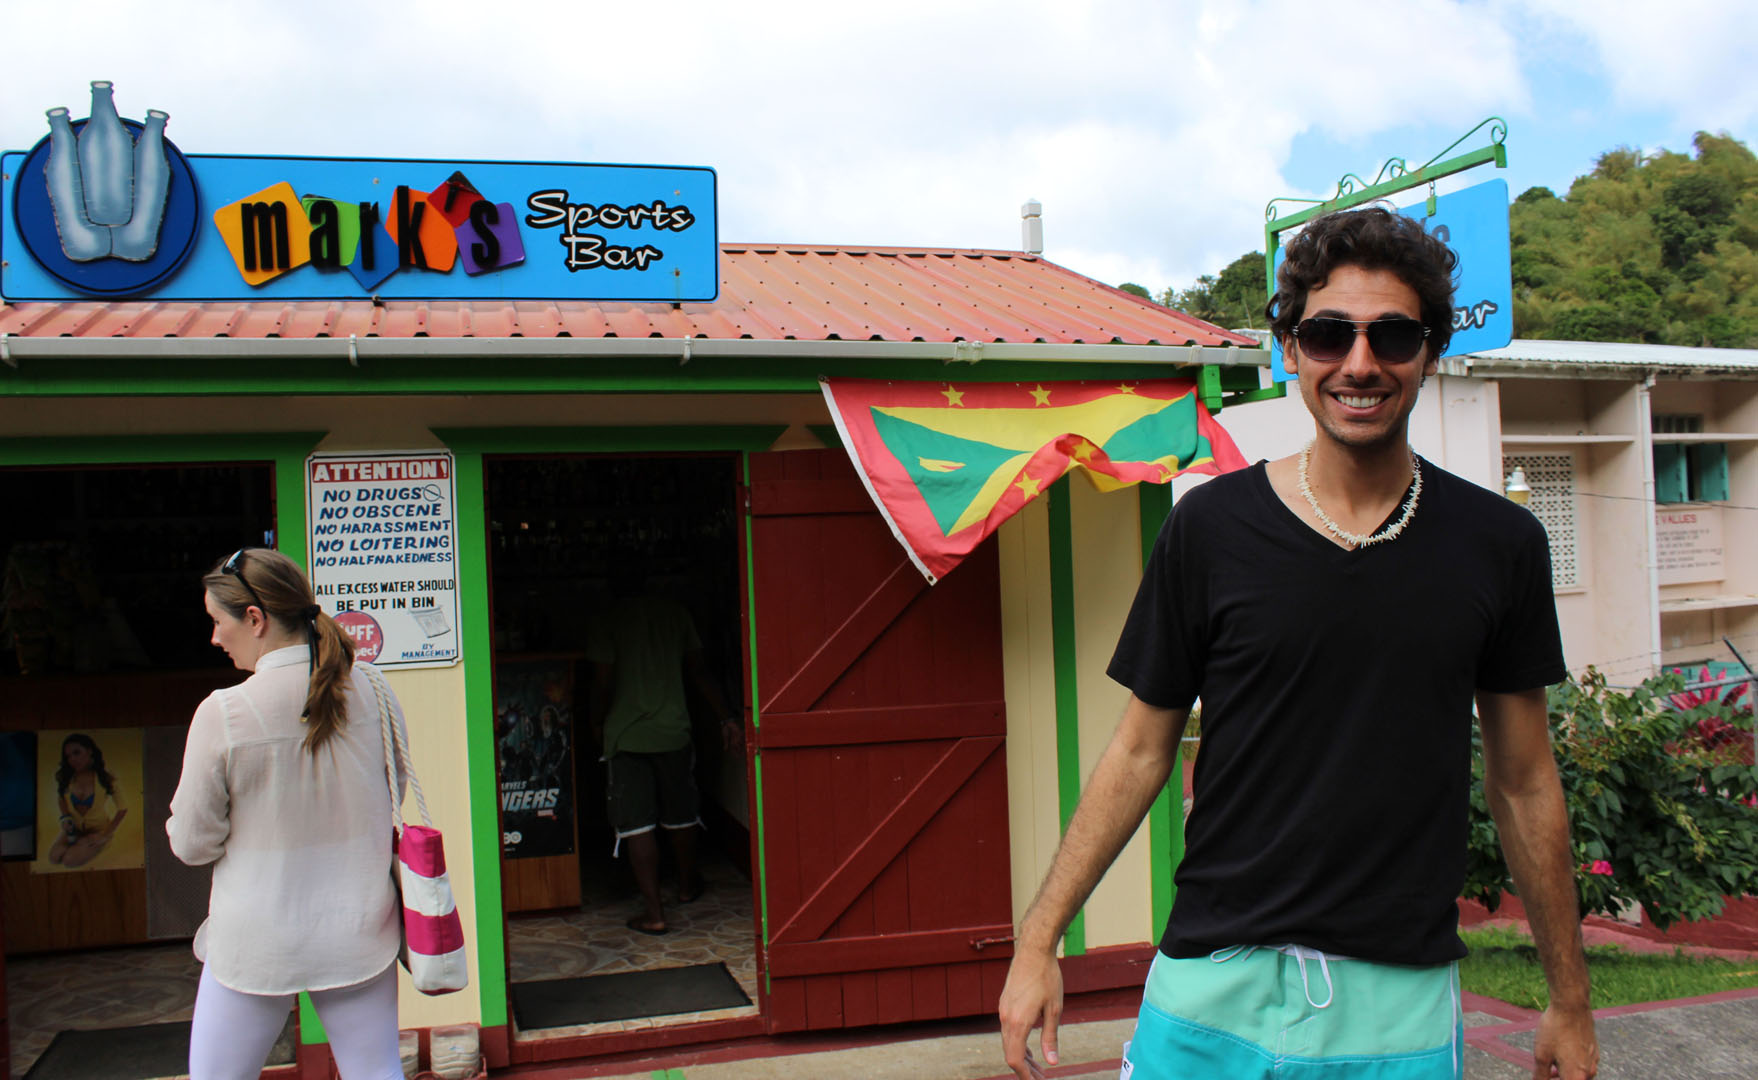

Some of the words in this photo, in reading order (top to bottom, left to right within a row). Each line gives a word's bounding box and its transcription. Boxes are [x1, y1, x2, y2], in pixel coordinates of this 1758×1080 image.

[526, 190, 695, 235] Sports
[241, 183, 499, 273] mark's
[563, 233, 663, 271] Bar
[1452, 300, 1498, 333] ar
[323, 489, 350, 503] NO
[356, 487, 422, 501] DRUGS
[319, 506, 348, 520] NO
[352, 503, 442, 518] OBSCENE
[1661, 514, 1697, 524] VALUES
[314, 523, 337, 535] NO
[340, 519, 451, 534] HARASSMENT
[315, 539, 343, 552] NO
[350, 535, 450, 551] LOITERING
[315, 556, 336, 567] NO
[339, 552, 452, 566] HALFNAKEDNESS
[316, 584, 335, 596] ALL
[338, 582, 378, 595] EXCESS
[380, 580, 415, 593] WATER
[418, 579, 454, 591] SHOULD
[336, 600, 354, 611] BE
[360, 598, 387, 610] PUT
[392, 598, 406, 609] IN
[411, 596, 435, 608] BIN
[401, 649, 455, 658] MANAGEMENT
[502, 788, 560, 812] NGERS
